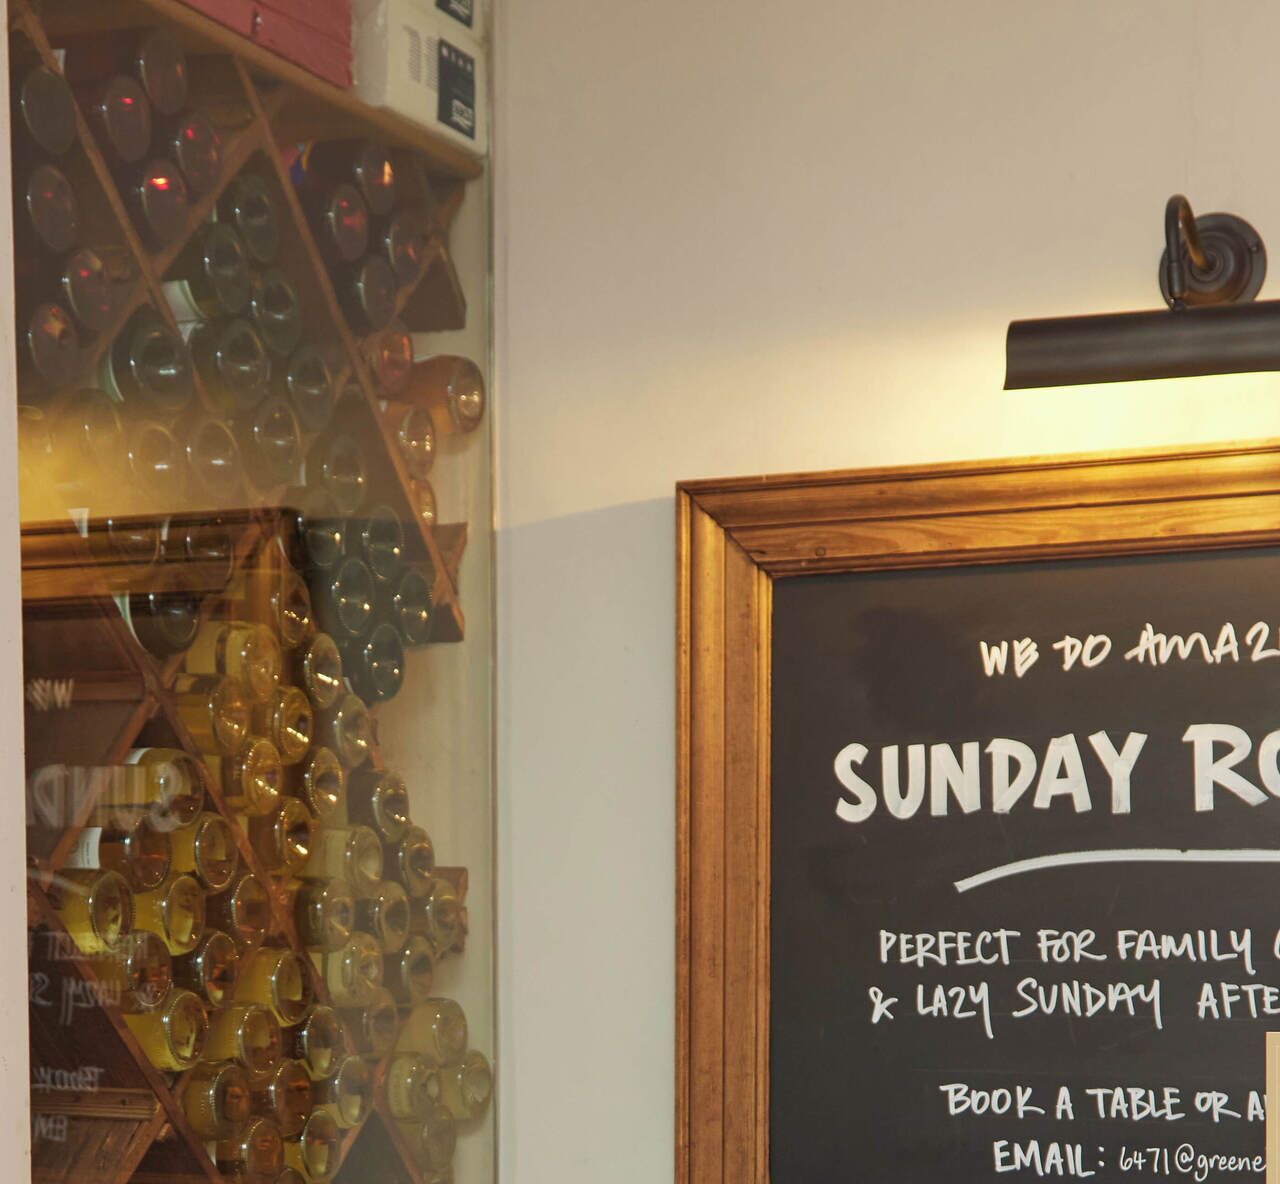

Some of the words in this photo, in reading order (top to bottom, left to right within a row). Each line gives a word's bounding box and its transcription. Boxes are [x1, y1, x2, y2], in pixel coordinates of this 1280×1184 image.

[979, 637, 1040, 678] WE
[1051, 634, 1112, 672] DO
[833, 730, 1148, 824] SUNDAY
[879, 928, 1021, 967] PERFECT
[1036, 928, 1108, 963] FOR
[1116, 928, 1257, 976] FAMILY
[868, 986, 899, 1024] &
[916, 981, 994, 1040] LAZY
[1011, 976, 1163, 1030] SUNDAY
[938, 1083, 1046, 1119] BOOK
[1055, 1085, 1075, 1121] A
[1085, 1086, 1186, 1121] TABLE
[1194, 1090, 1242, 1123] OR
[1247, 1090, 1267, 1122] A
[993, 1139, 1106, 1178] EMAIL:
